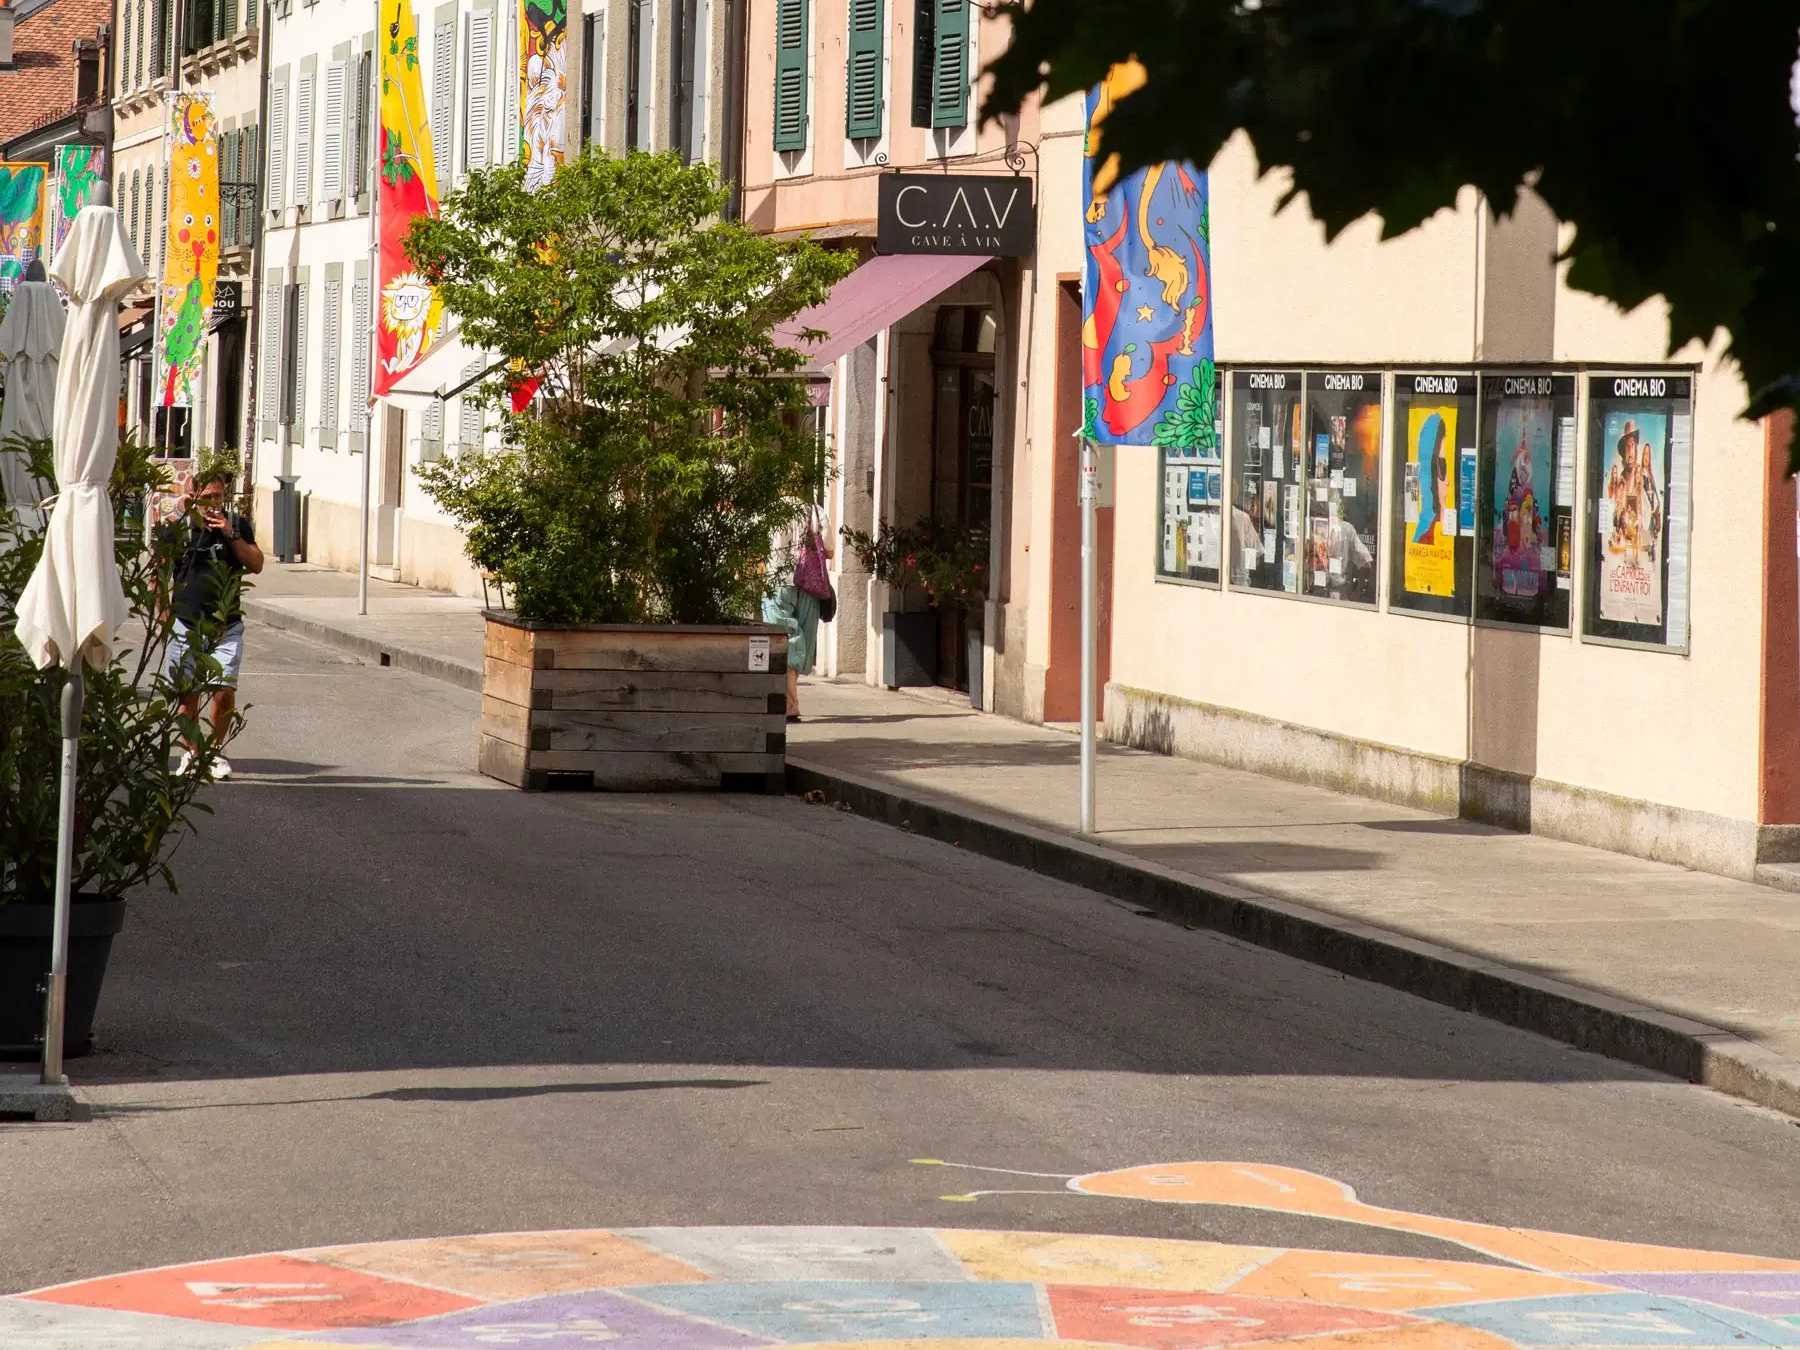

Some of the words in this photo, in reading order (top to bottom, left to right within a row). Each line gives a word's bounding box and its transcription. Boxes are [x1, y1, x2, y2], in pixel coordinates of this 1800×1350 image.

[911, 235, 951, 247] CAVE
[958, 233, 967, 247] À
[976, 236, 1001, 247] VIN
[1249, 373, 1273, 389] CINEMA
[1274, 374, 1286, 389] BIO
[1324, 374, 1350, 390] CINEMA
[1351, 375, 1363, 390] BIO
[1414, 376, 1443, 393] CINEMA
[1445, 377, 1457, 394] BIO
[1504, 377, 1537, 395] CINEMA
[1537, 378, 1552, 395] BIO
[1614, 378, 1648, 397] CINEMA
[1650, 379, 1665, 397] BIO
[1617, 565, 1645, 581] CAPRICES
